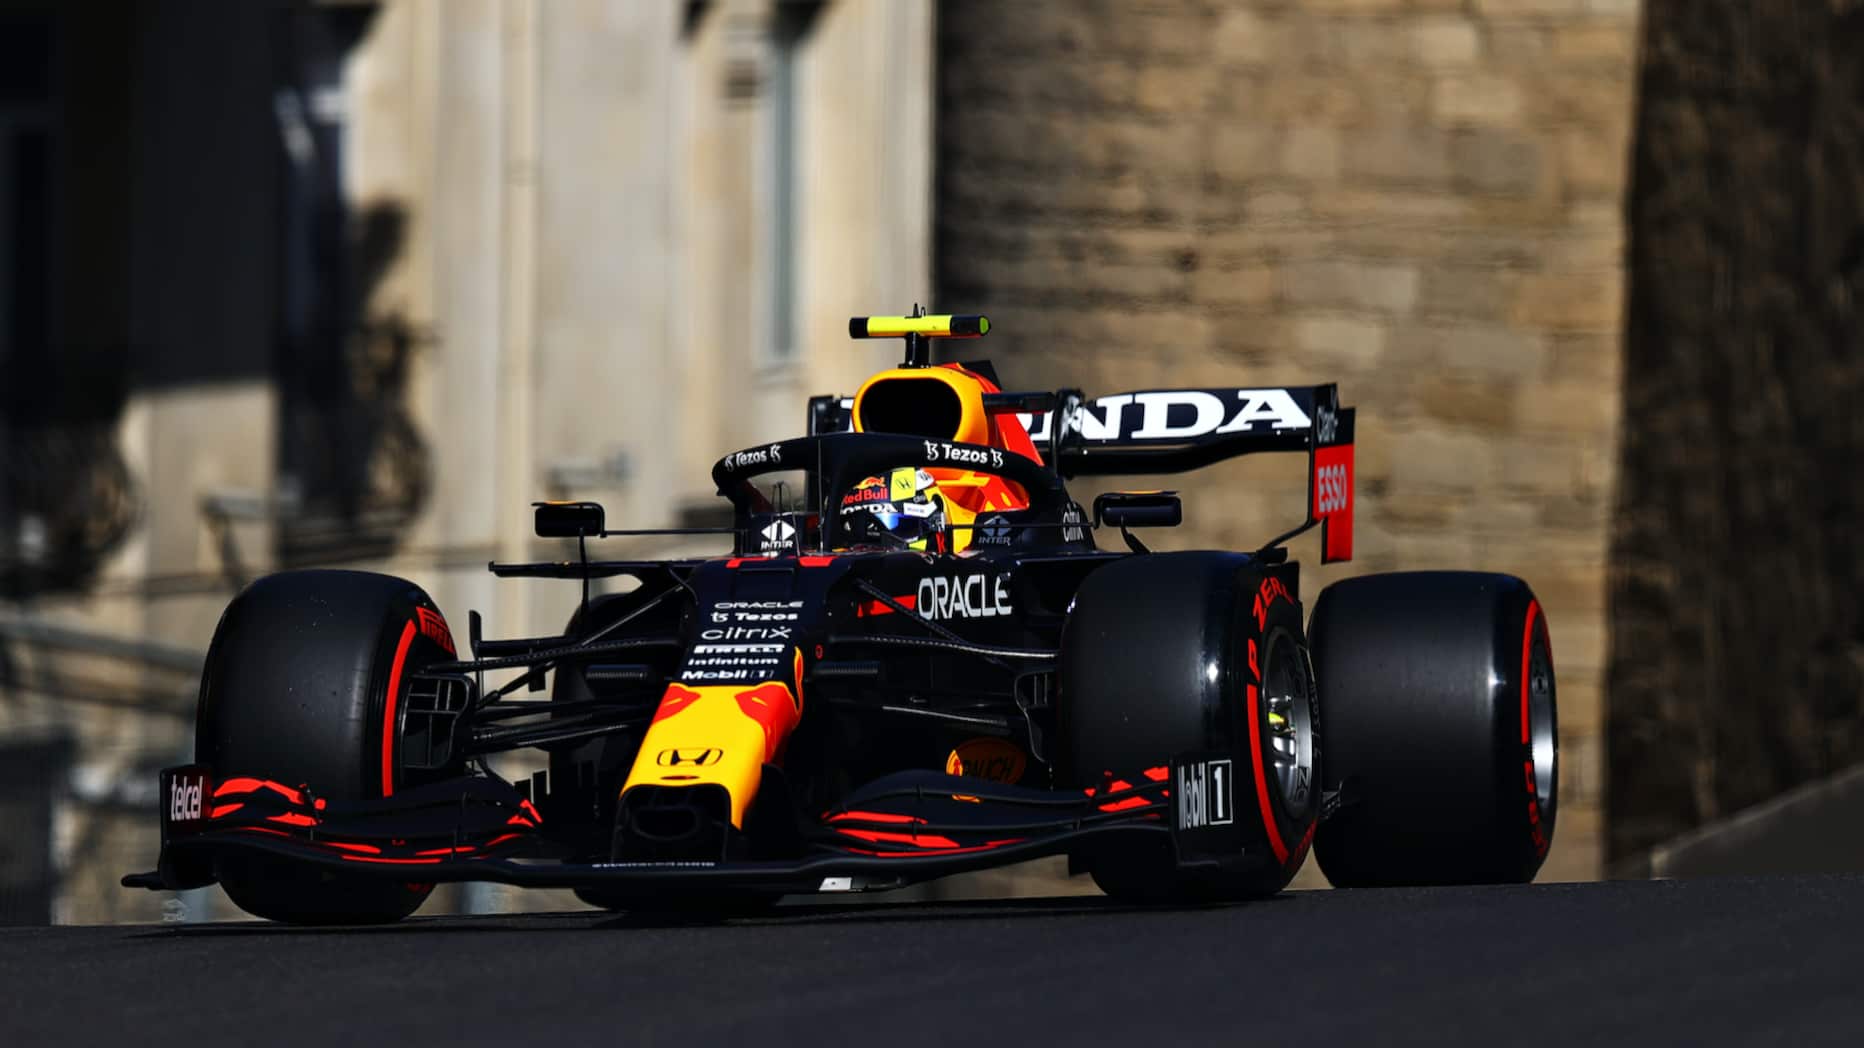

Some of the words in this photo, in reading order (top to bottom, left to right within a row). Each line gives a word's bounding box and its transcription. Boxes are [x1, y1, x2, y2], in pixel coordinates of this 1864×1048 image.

[736, 450, 767, 466] Tezos
[941, 443, 988, 464] Tezos
[863, 488, 888, 500] Bull
[1318, 464, 1347, 512] ESSO
[979, 536, 1011, 546] INTER
[918, 574, 1012, 620] ORACLE
[714, 601, 804, 609] ORACLE
[735, 612, 798, 621] Tezos
[701, 626, 793, 640] citrix
[693, 644, 785, 654] PIRELLI
[688, 658, 779, 666] infinitum
[681, 670, 747, 680] Mobil
[171, 774, 203, 821] telcel
[1178, 762, 1207, 831] Mobil
